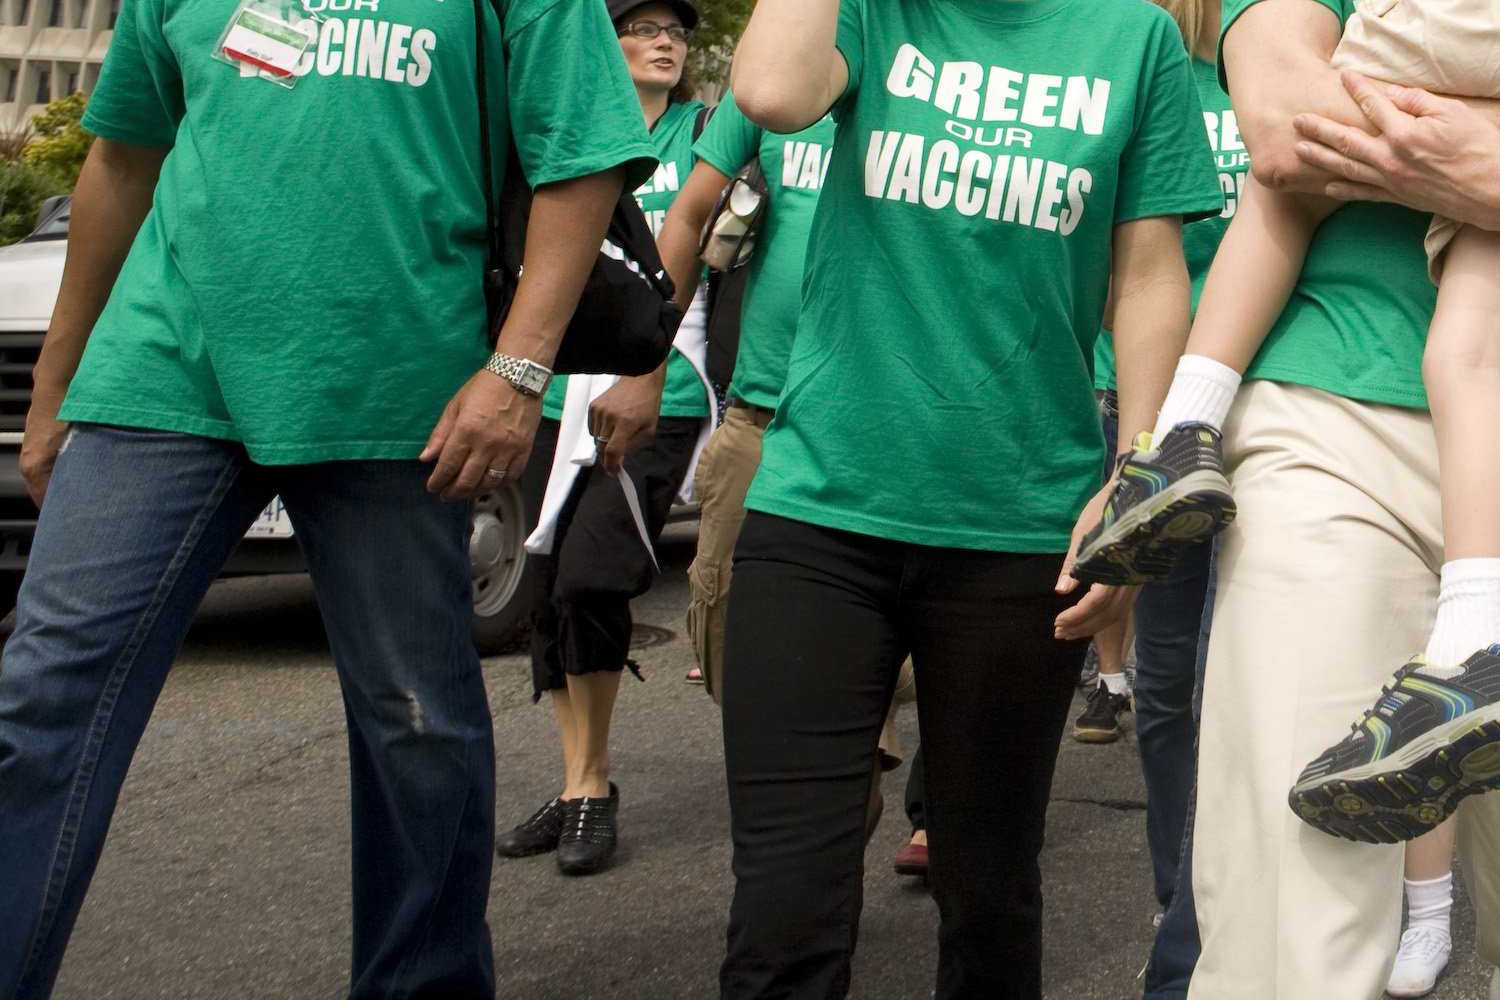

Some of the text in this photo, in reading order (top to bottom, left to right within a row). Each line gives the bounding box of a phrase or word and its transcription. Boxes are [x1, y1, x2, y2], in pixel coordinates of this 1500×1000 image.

[886, 43, 1112, 135] GREEN
[945, 119, 1033, 148] OUR
[864, 130, 1093, 237] VACCINES
